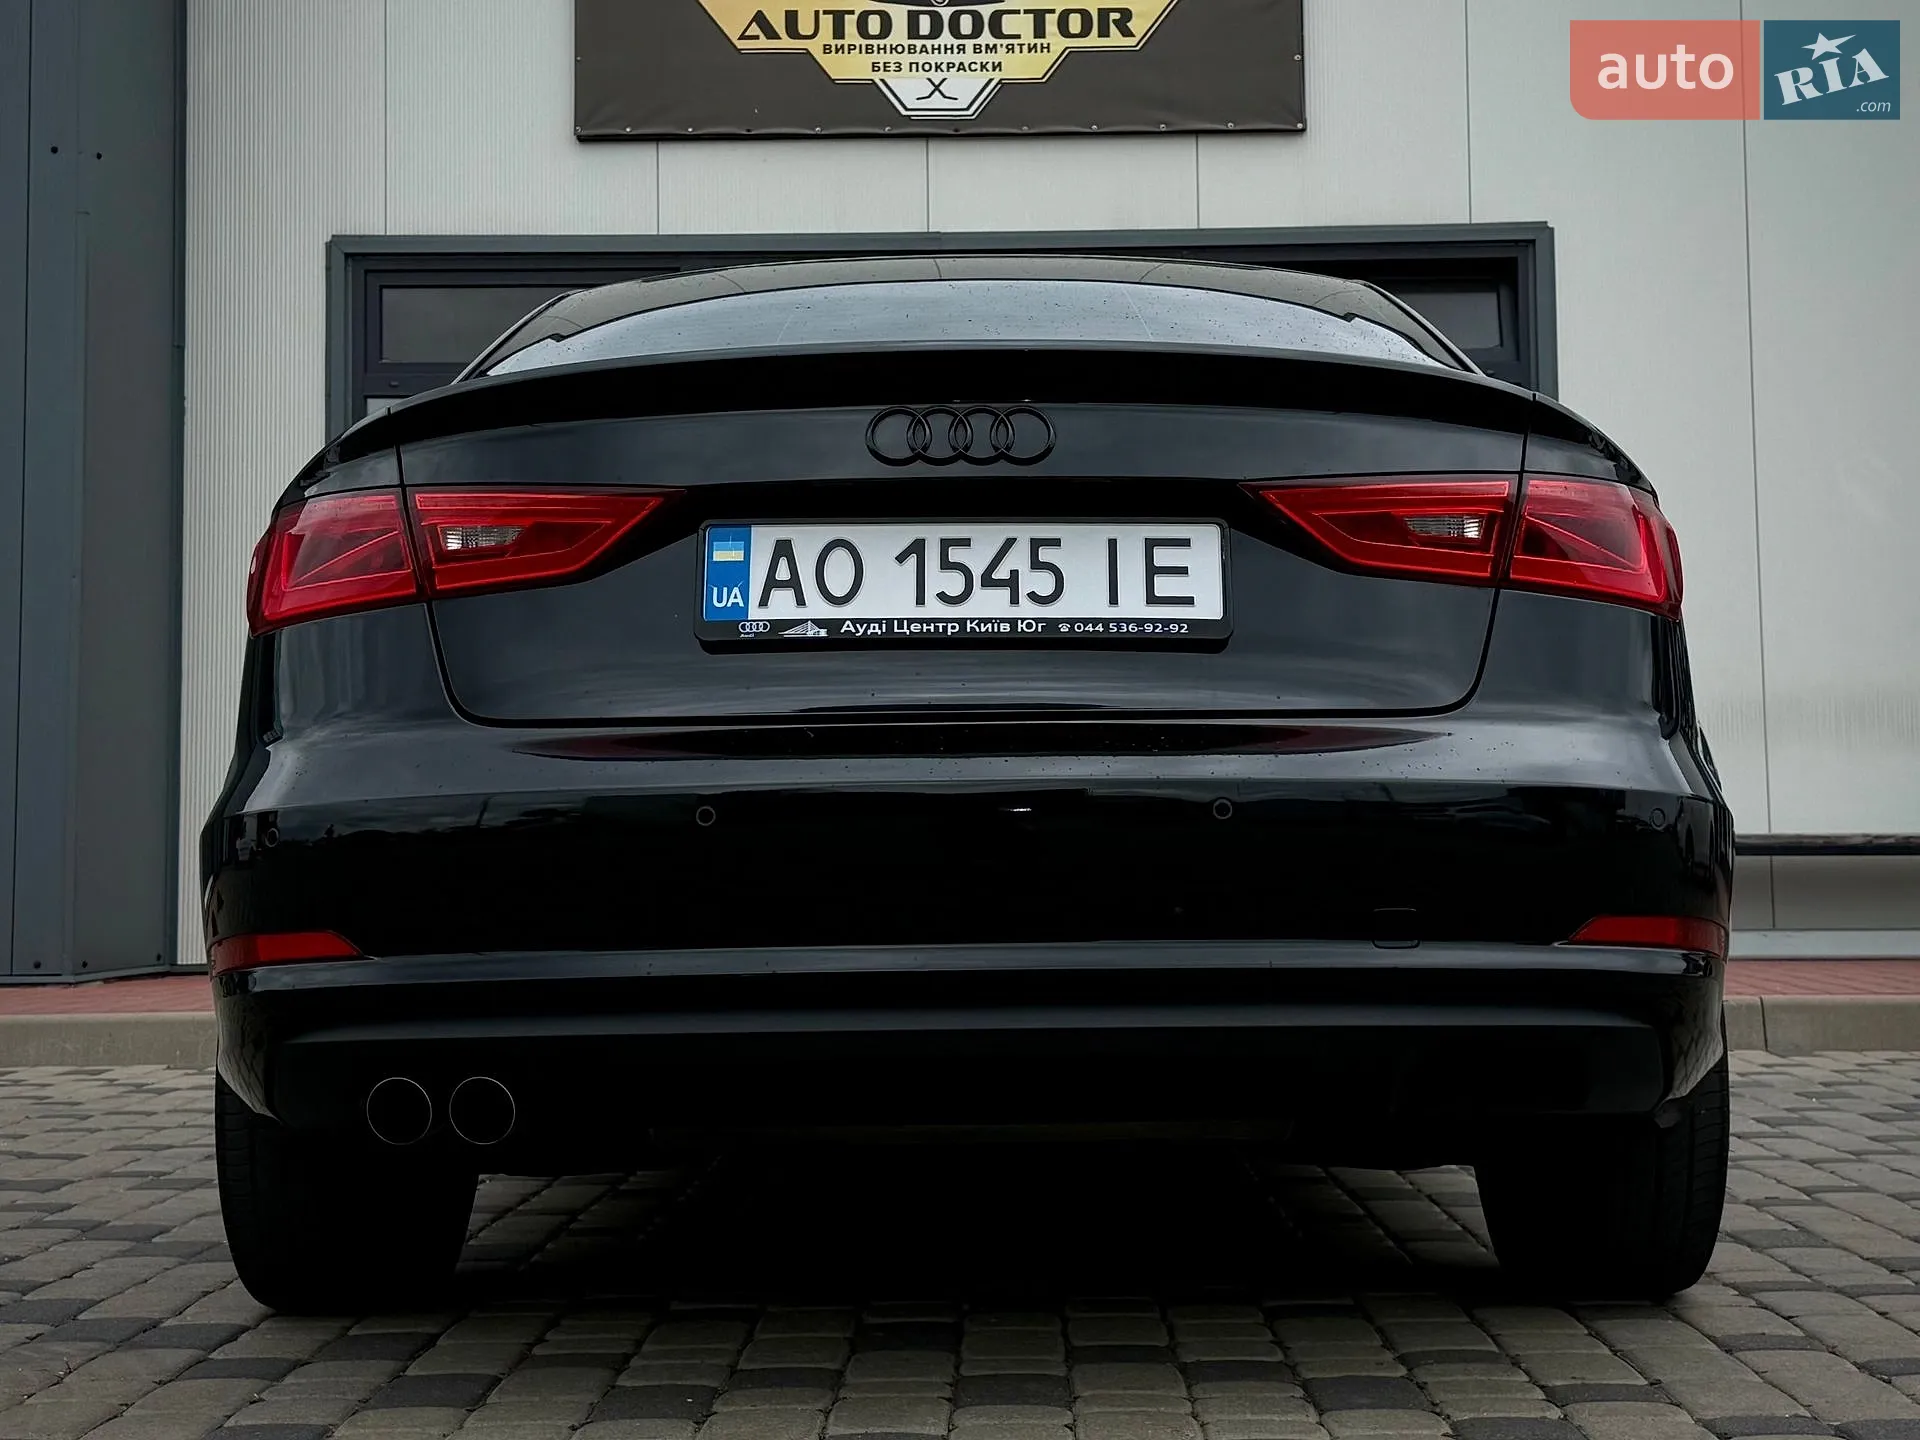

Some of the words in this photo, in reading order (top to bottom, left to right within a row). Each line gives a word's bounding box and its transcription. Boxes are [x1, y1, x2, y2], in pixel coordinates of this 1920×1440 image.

[737, 9, 894, 41] AUTO
[907, 7, 1137, 41] DOCTOR
[822, 43, 966, 55] ВИРІВНЮВАННЯ
[972, 42, 1051, 55] ВМ'ЯТИН
[871, 61, 903, 73] БЕЗ
[908, 61, 1003, 73] ПОКРАСКИ
[758, 537, 865, 609] AO
[894, 536, 1065, 607] 1545
[1107, 537, 1195, 607] IE
[711, 585, 745, 608] UA
[840, 620, 887, 636] Ауді
[893, 620, 960, 635] Центр
[966, 619, 1011, 633] Київ
[1017, 619, 1047, 633] Юг
[1074, 622, 1104, 633] 044
[1108, 623, 1189, 634] 536-92-92
